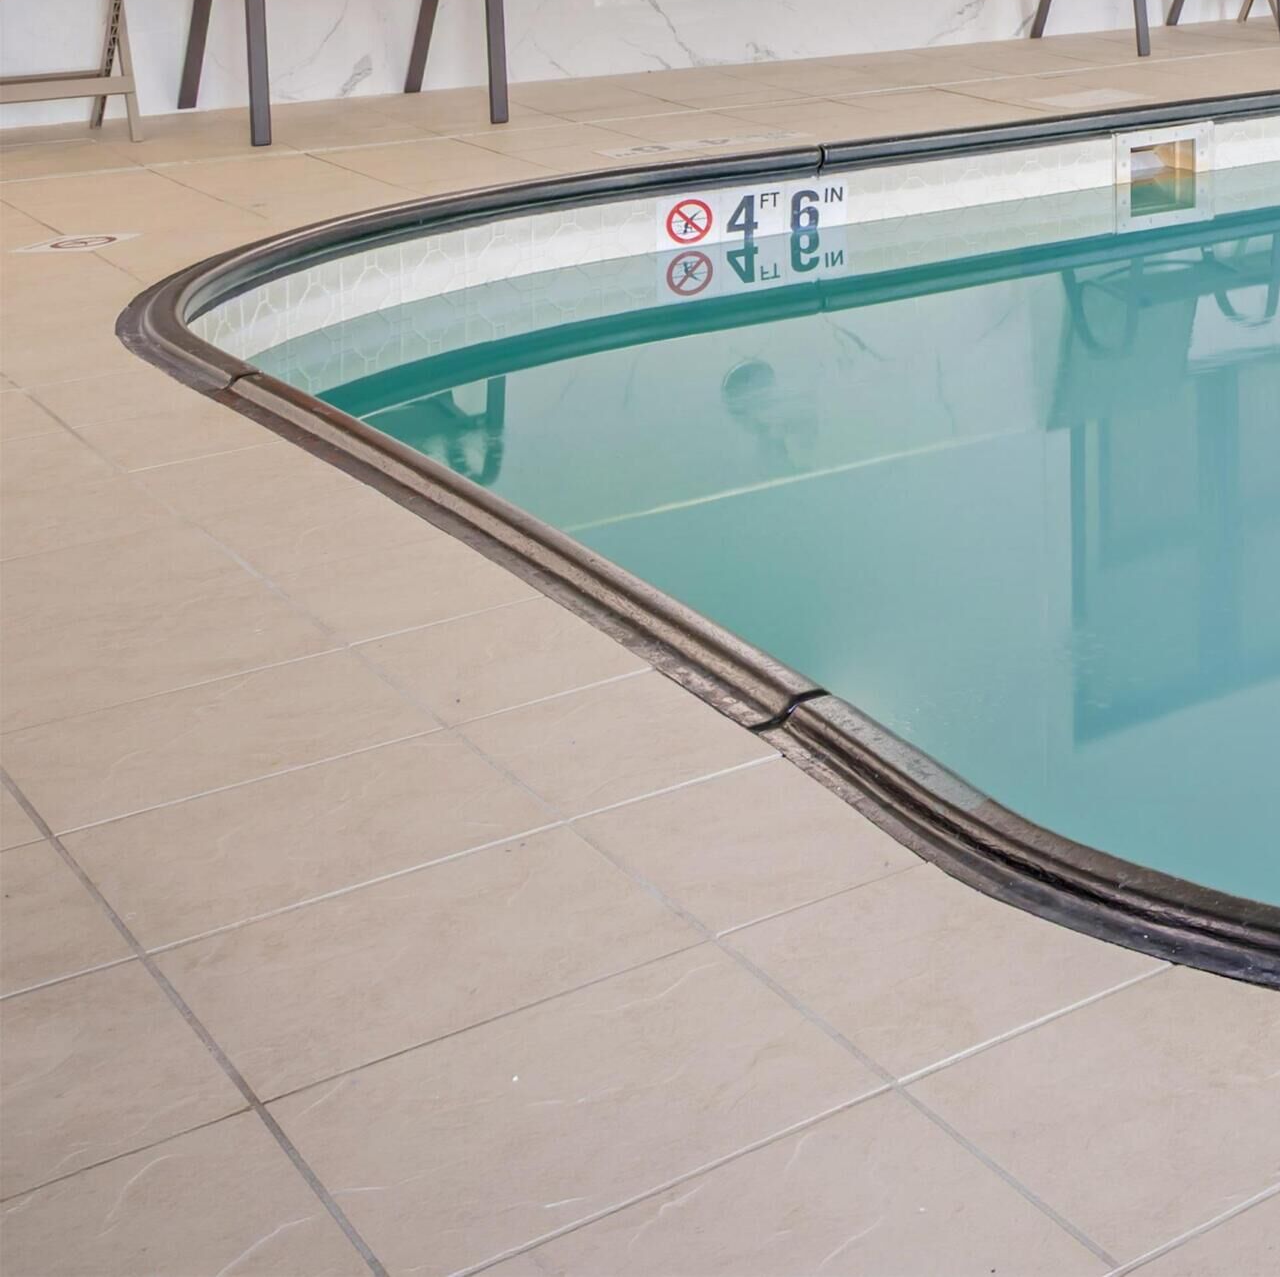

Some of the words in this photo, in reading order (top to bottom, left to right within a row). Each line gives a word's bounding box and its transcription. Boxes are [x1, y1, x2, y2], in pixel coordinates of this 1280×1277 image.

[726, 194, 759, 240] 4
[760, 191, 780, 209] FT
[790, 189, 820, 231] 6
[824, 186, 844, 203] IN
